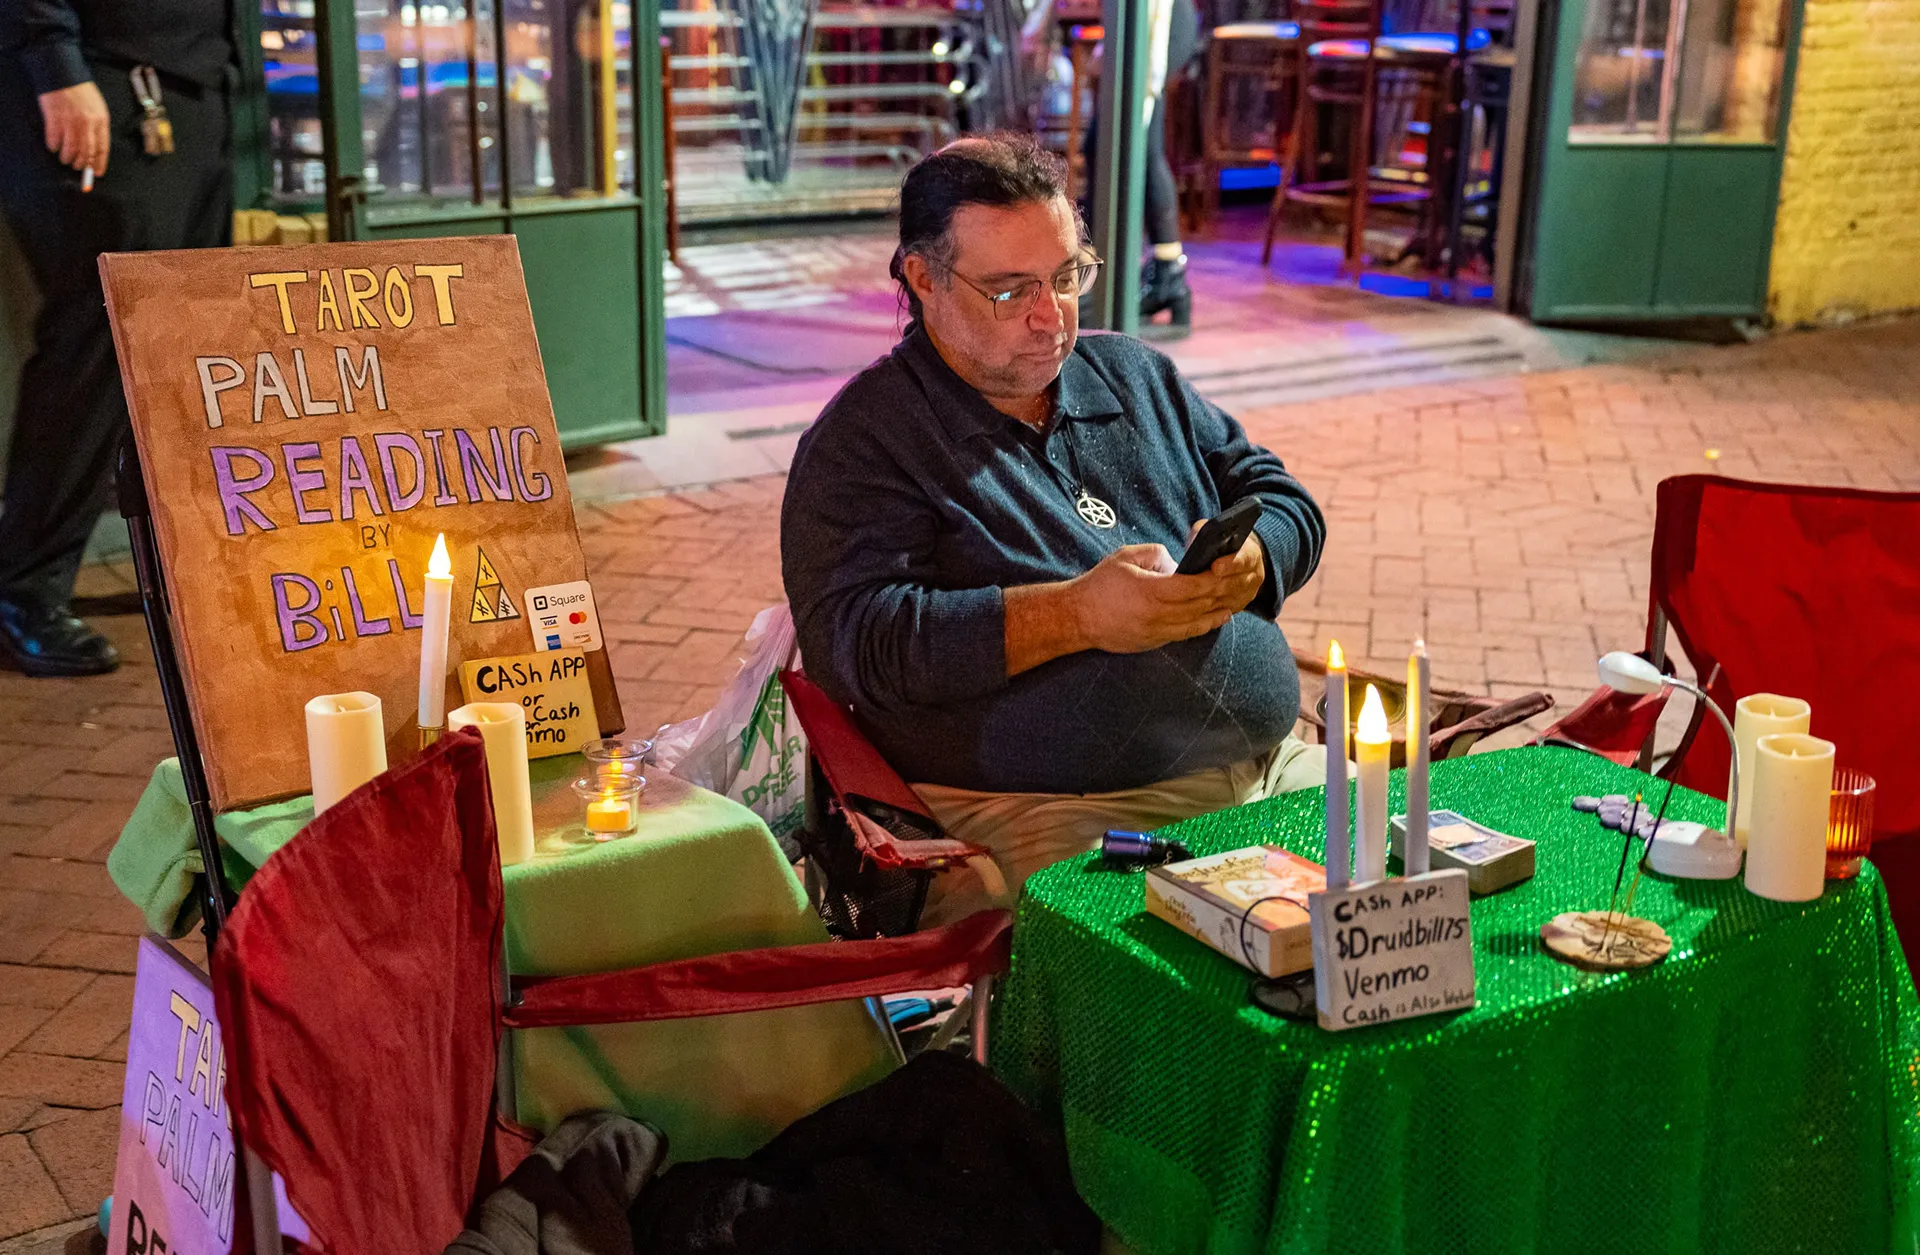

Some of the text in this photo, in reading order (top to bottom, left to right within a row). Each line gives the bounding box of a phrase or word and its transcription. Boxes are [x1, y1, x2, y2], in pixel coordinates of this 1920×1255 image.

[249, 264, 463, 334] TAROT
[195, 345, 389, 428] PALM
[209, 426, 554, 535] READING
[361, 524, 392, 549] BY
[550, 593, 586, 607] Square
[550, 656, 585, 681] APP
[522, 694, 545, 707] or
[533, 702, 580, 722] Cash
[526, 728, 566, 743] nmo
[1402, 885, 1444, 907] APP:
[1344, 964, 1429, 1000] Venmo
[1343, 1004, 1390, 1024] Cash
[139, 1070, 236, 1245] PALM
